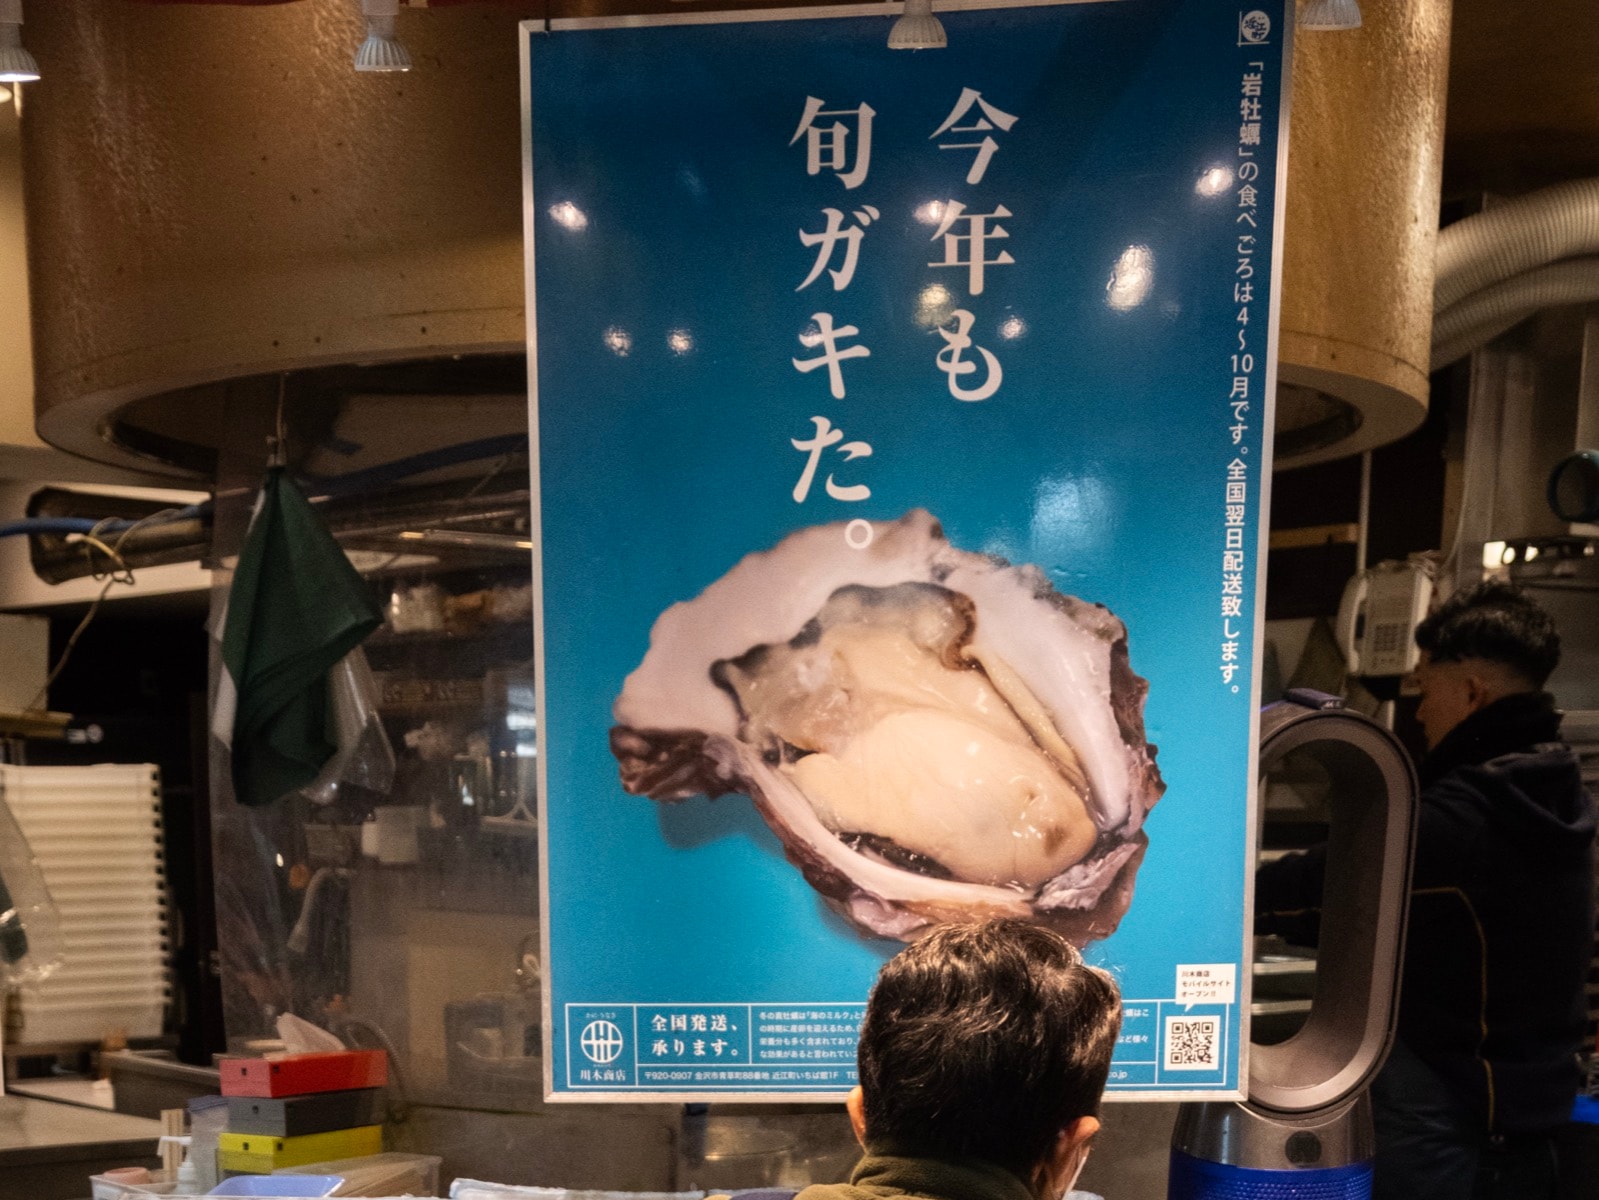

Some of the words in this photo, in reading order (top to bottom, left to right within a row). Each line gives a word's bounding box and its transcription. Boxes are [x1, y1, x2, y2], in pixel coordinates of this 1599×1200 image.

[929, 86, 1020, 402] 今年も
[788, 95, 881, 551] 旬ガキた。
[652, 1013, 738, 1033] 全国発送、
[652, 1038, 738, 1057] 承ります。
[580, 1068, 626, 1081] 川木商店
